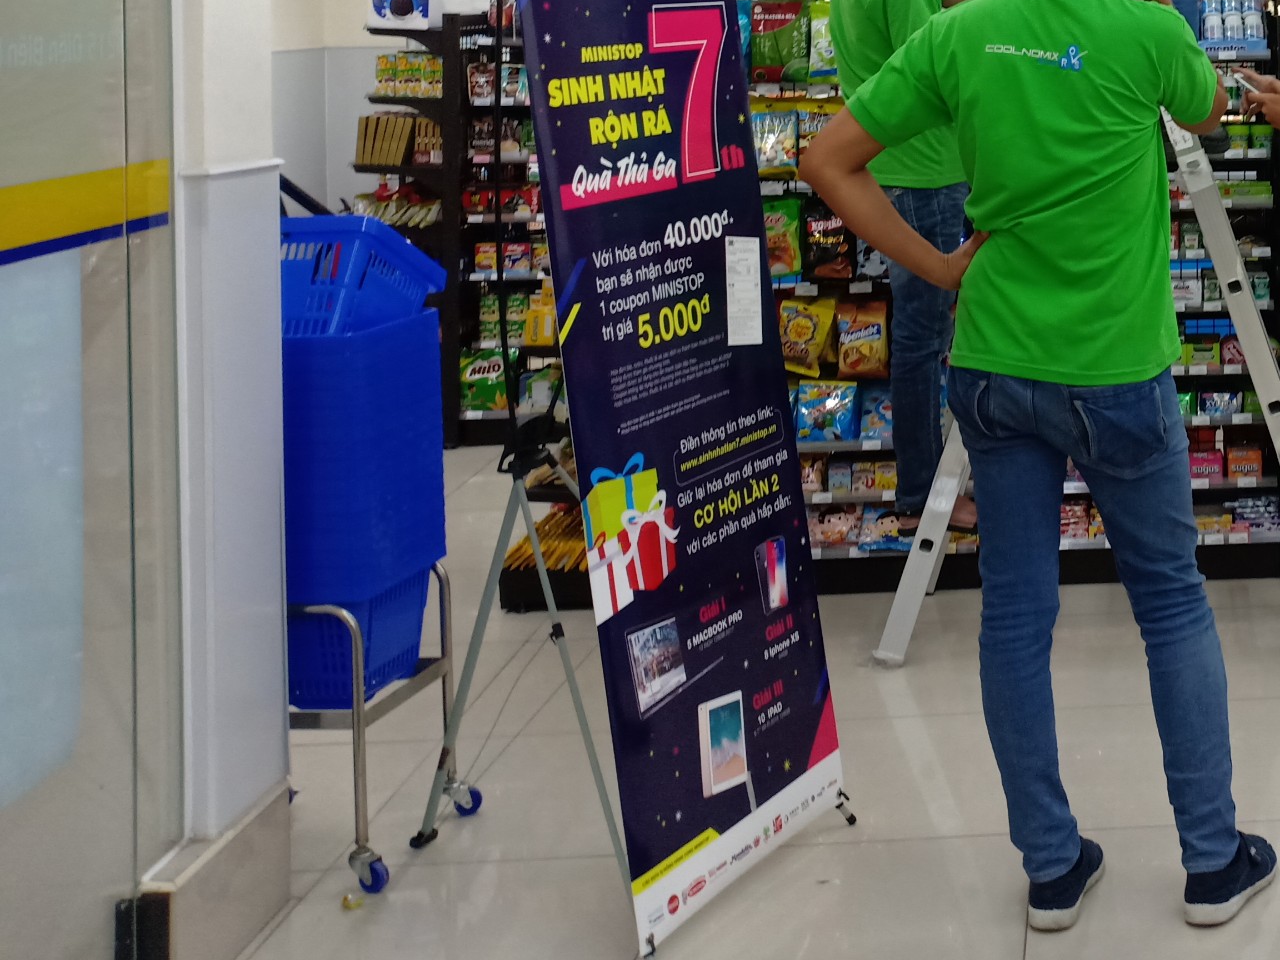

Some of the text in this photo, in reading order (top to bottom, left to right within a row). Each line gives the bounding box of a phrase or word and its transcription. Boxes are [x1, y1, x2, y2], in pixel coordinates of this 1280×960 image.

[581, 42, 644, 63] MINISTOP
[985, 44, 1059, 61] COOLNOMIX
[548, 65, 666, 108] SINH NHẬT
[588, 108, 640, 150] RỘN
[571, 151, 677, 199] Quà Thả Ga
[592, 246, 613, 270] Với
[615, 244, 637, 265] hóa
[639, 239, 662, 261] đơn
[596, 255, 693, 295] bạn sẽ nhận được
[600, 272, 705, 316] 1 coupon MINISTOP
[602, 292, 711, 349] trị giá 5.000đ
[469, 363, 502, 378] MILO
[680, 436, 700, 454] Điền
[701, 424, 725, 444] thông
[726, 420, 737, 433] tin
[738, 414, 756, 429] theo
[677, 490, 693, 508] Giữ
[695, 486, 705, 503] lại
[706, 478, 722, 494] hóa
[724, 470, 741, 487] đơn
[754, 456, 774, 473] tham
[775, 448, 788, 465] gia
[1192, 464, 1219, 474] sugus
[1231, 464, 1258, 473] sugus
[693, 472, 780, 529] CƠ HỘI LẦN 2
[686, 539, 700, 557] với
[702, 533, 718, 551] các
[719, 517, 740, 543] phần
[741, 509, 756, 529] quà
[757, 501, 772, 518] hấp
[692, 618, 728, 648] MACBOOK
[728, 608, 743, 627] PRO
[758, 712, 766, 725] 10
